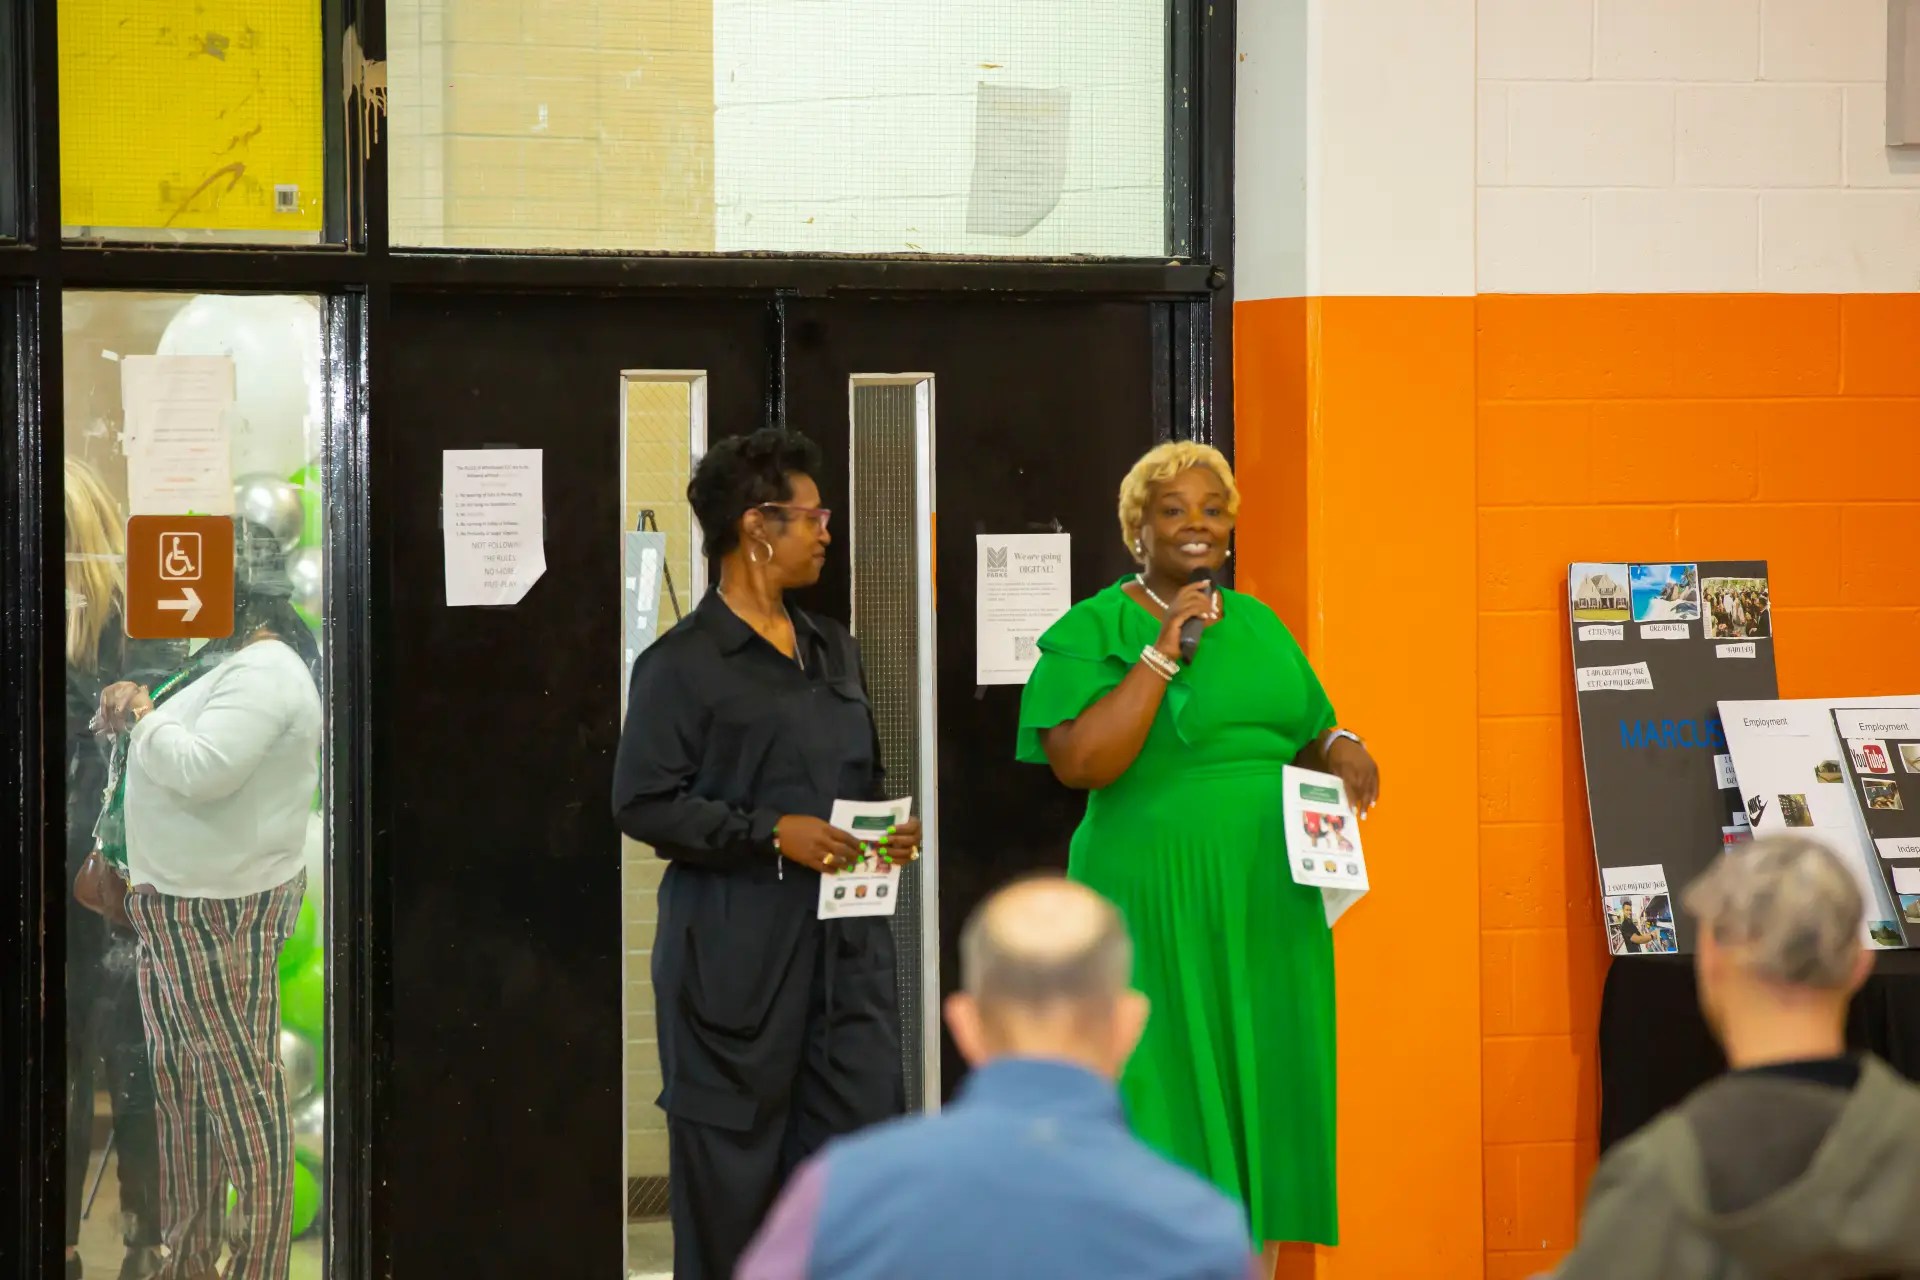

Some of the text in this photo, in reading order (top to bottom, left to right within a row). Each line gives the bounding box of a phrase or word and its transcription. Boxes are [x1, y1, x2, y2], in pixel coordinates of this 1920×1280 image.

[1014, 552, 1026, 560] We
[1040, 552, 1062, 563] going
[1019, 565, 1054, 574] DIGITAL!
[1743, 717, 1788, 728] Employment
[1858, 722, 1909, 733] Employment
[1619, 719, 1725, 750] MARCUS
[1850, 748, 1886, 770] YouTube
[1747, 794, 1762, 815] NIKE
